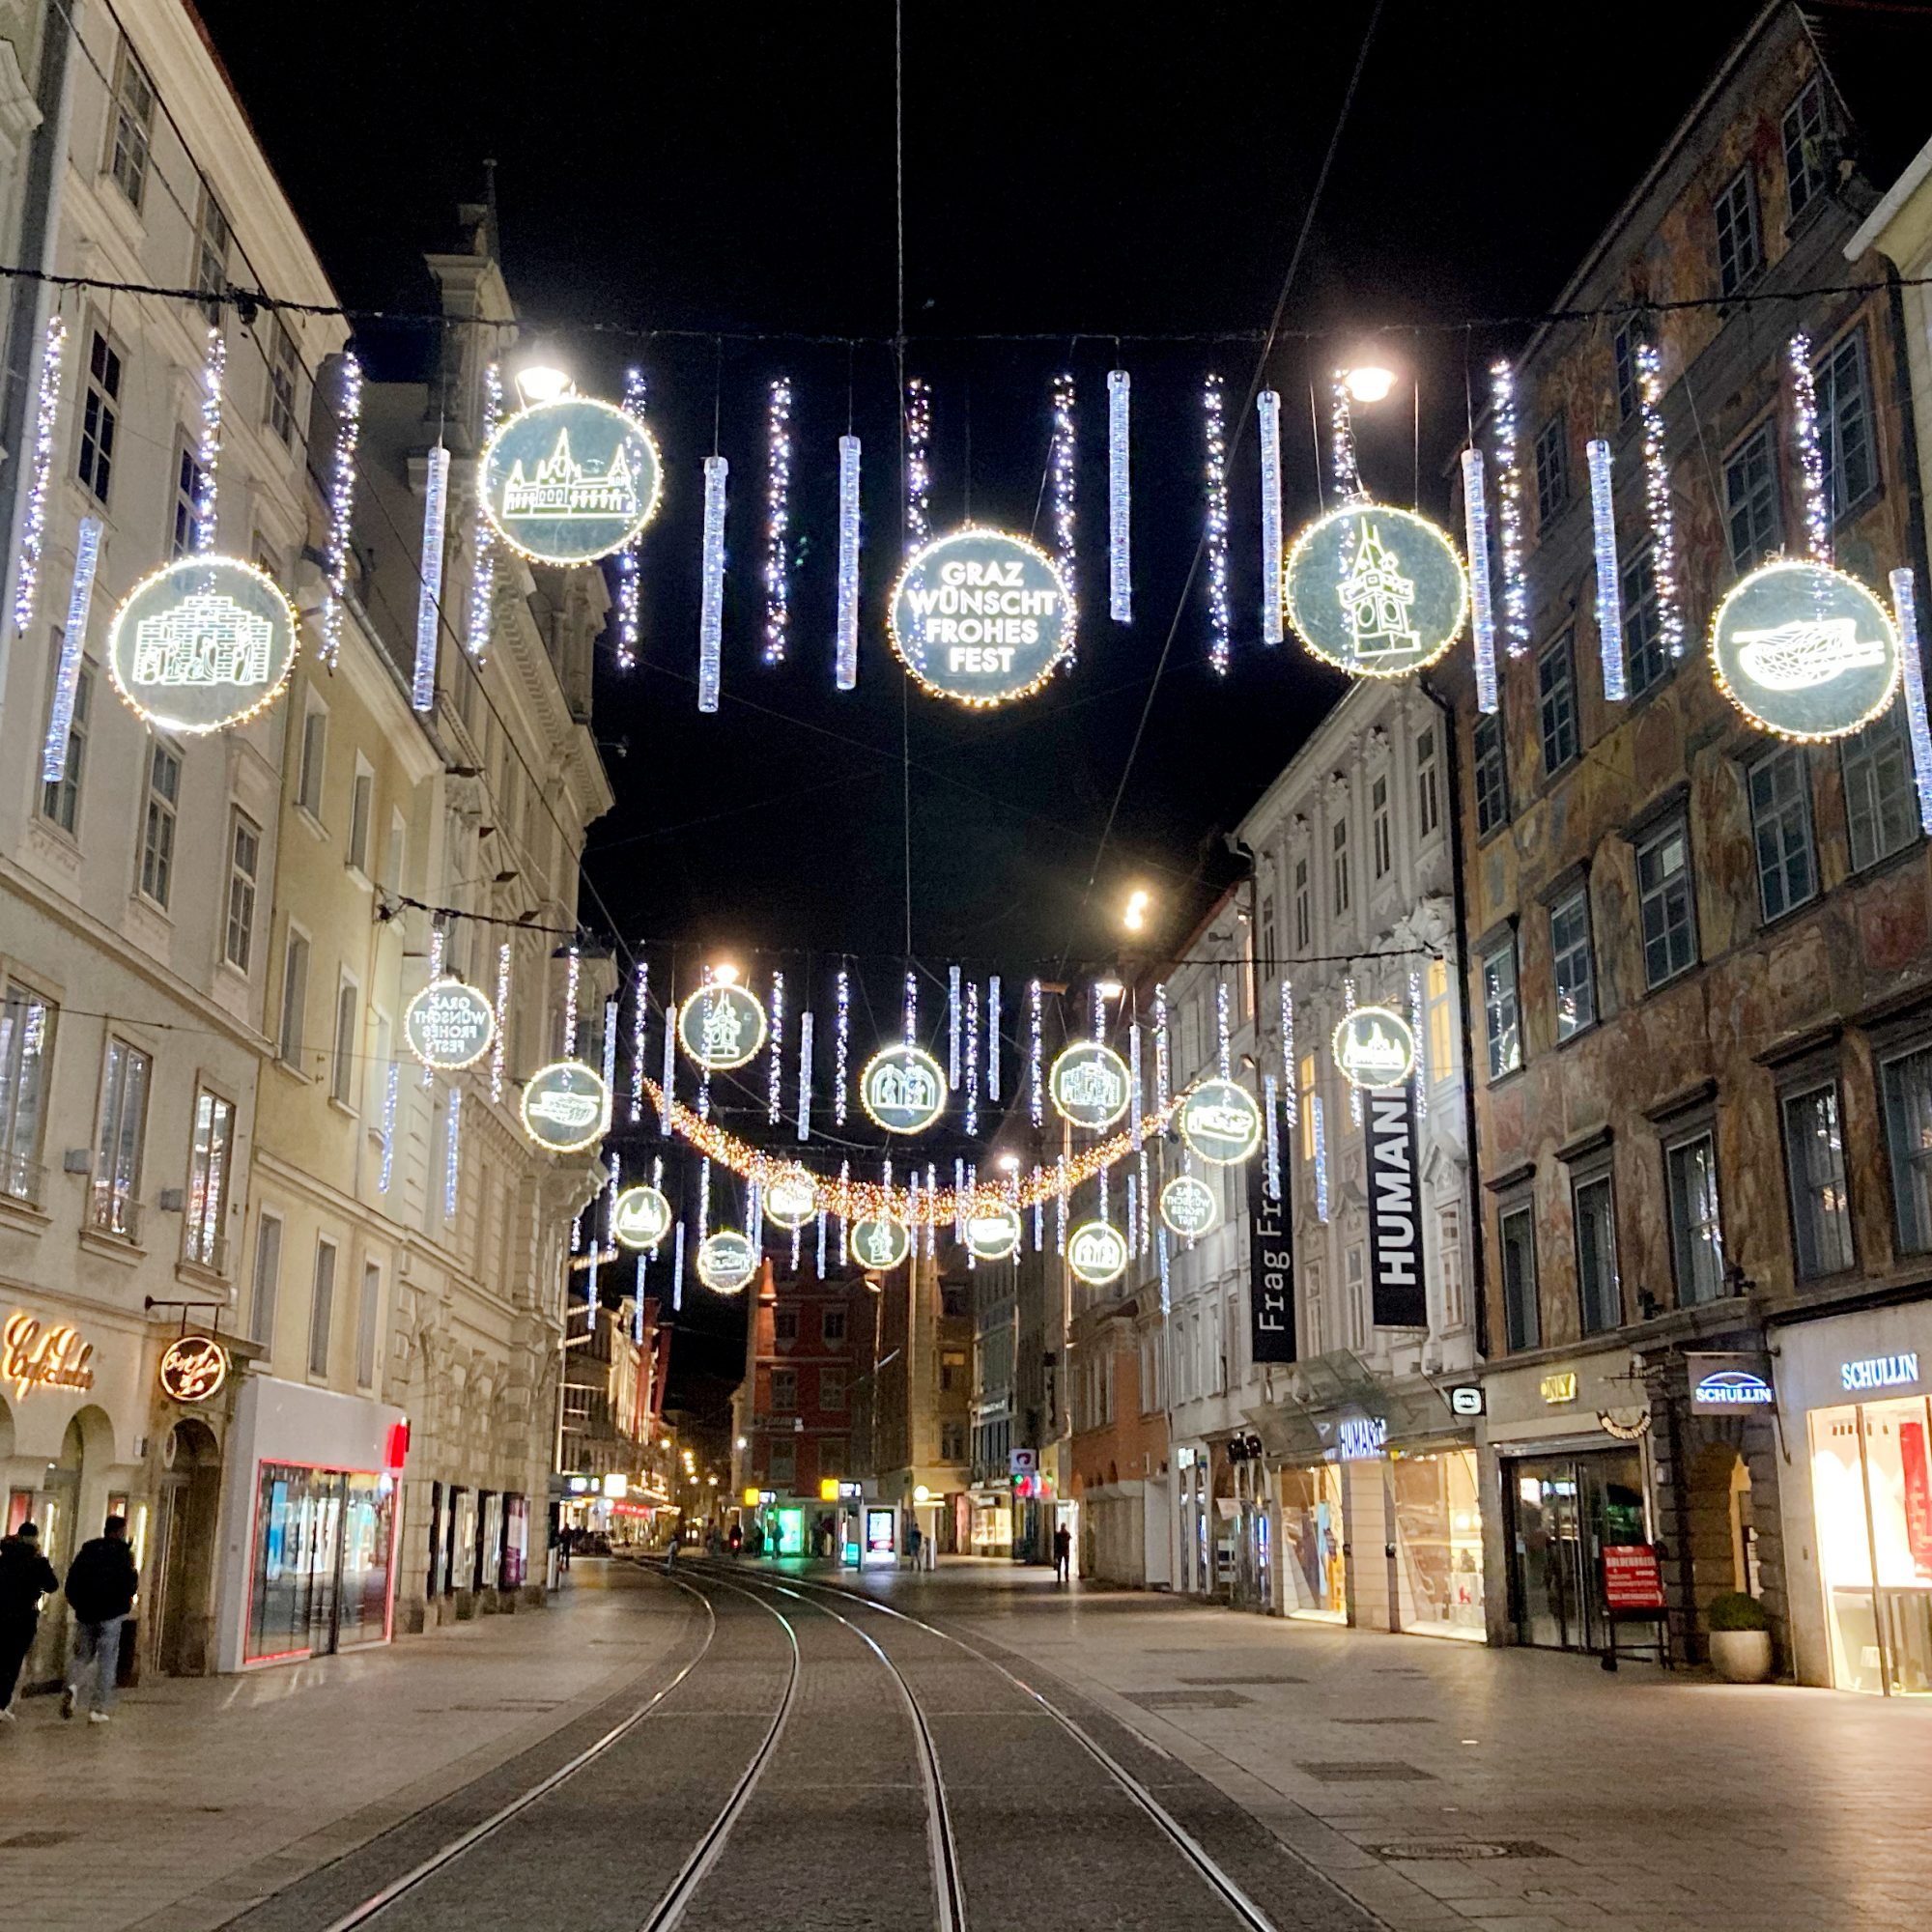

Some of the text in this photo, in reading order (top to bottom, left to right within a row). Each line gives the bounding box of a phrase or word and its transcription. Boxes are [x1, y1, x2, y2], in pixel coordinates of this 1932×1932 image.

[942, 561, 1025, 586] GRAZ
[907, 585, 1058, 615] WÜNSCHT
[925, 618, 1039, 643] FROHES
[950, 647, 1015, 672] FEST
[1259, 1251, 1291, 1331] Frag
[1840, 1352, 1919, 1391] SCHULLIN
[1695, 1387, 1774, 1404] SCHULLIN
